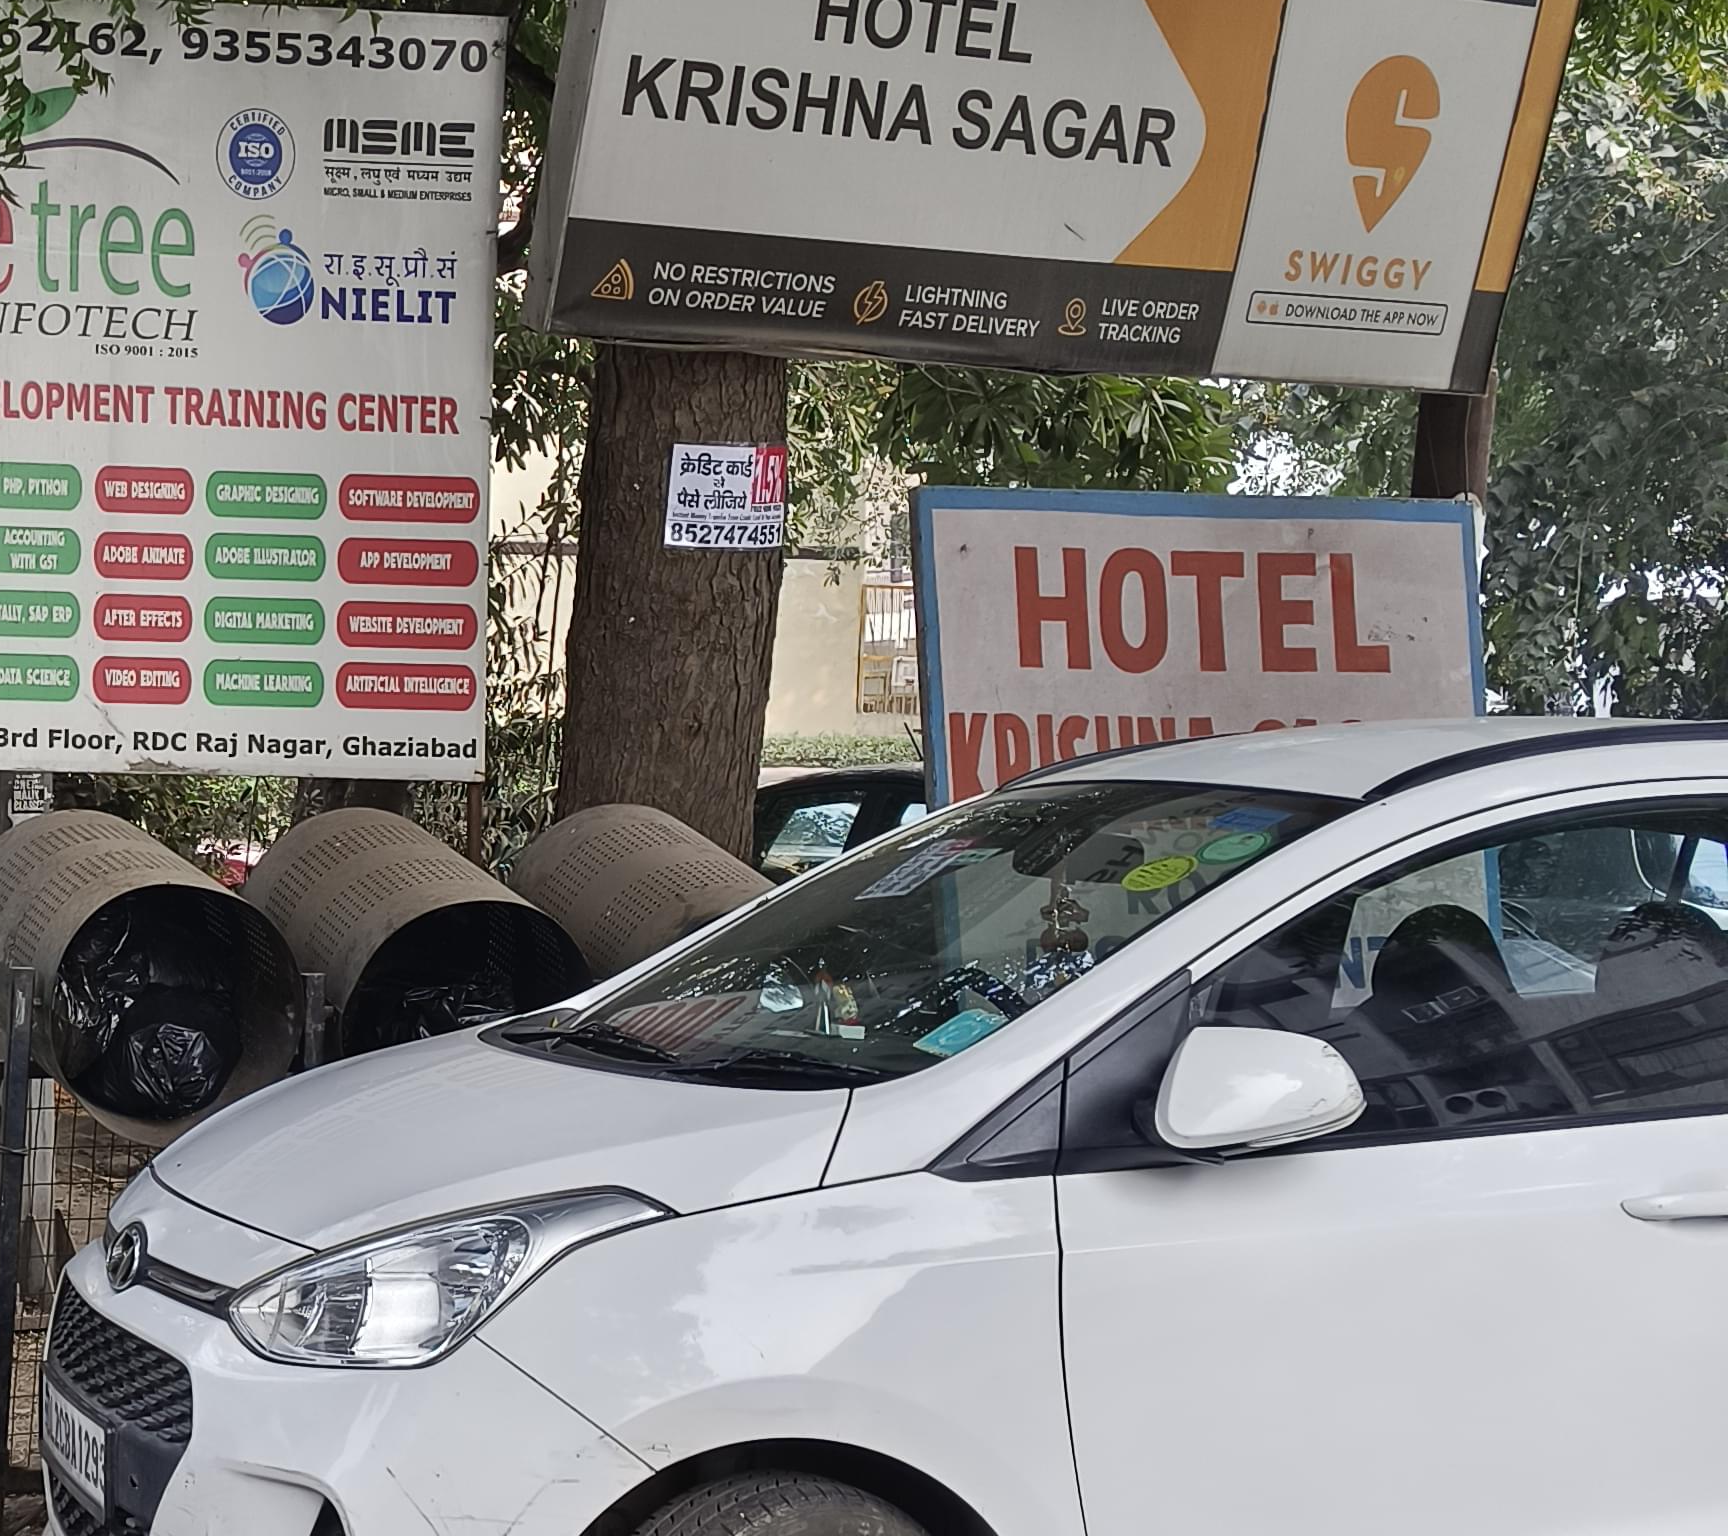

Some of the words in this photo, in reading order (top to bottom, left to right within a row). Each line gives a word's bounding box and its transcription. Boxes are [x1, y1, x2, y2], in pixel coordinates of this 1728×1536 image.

[181, 27, 488, 72] 9355343070
[621, 54, 932, 144] KRISHNA
[952, 89, 1176, 167] SAGAR
[230, 112, 286, 135] CERTIFIED
[324, 118, 475, 158] MSME
[238, 141, 275, 159] ISO
[228, 175, 282, 197] COMPANY
[353, 188, 378, 199] SMALL
[419, 191, 472, 202] ENTERPRISES
[30, 179, 195, 298] tree
[653, 261, 685, 281] NO
[690, 265, 836, 294] RESTRICTIONS
[1284, 249, 1432, 291] SWIGGY
[321, 286, 456, 324] NIELIT
[648, 288, 680, 307] ON
[685, 291, 755, 313] ORDER
[761, 297, 826, 319] VALUE
[905, 284, 1008, 310] LIGHTNING
[1101, 298, 1139, 317] LIVE
[1142, 300, 1200, 321] ORDER
[1285, 304, 1356, 323] DOWNLOAD
[1359, 308, 1381, 324] THE
[1382, 310, 1405, 325] APP
[1407, 312, 1439, 328] NOW
[898, 310, 948, 330] FAST
[952, 313, 1040, 338] DELIVERY
[1098, 324, 1181, 344] TRACKING
[95, 343, 121, 356] ISO
[123, 344, 154, 357] 9001
[167, 345, 198, 359] 2015
[164, 386, 327, 431] TRAINING
[337, 392, 459, 435] CENTER
[28, 478, 69, 497] PYTHON
[104, 480, 128, 497] WEB
[131, 481, 186, 500] DESIGNING
[216, 484, 261, 502] GRAPHIC
[265, 485, 319, 505] DESIGNING
[349, 489, 403, 507] SOFTWARE
[407, 491, 474, 509] DEVELOPMENT
[3, 529, 65, 547] ACCOUNTING
[671, 523, 782, 545] 8527474551
[10, 552, 36, 570] WITH
[40, 553, 58, 570] GST
[103, 545, 138, 563] ADOBE
[142, 546, 185, 565] ANIMATE
[215, 546, 250, 564] ADOBE
[254, 547, 317, 567] ILLUSTRATOR
[360, 552, 379, 569] APP
[384, 553, 452, 571] DEVELOPMENT
[29, 605, 49, 623] SAP
[52, 605, 72, 624] ERP
[103, 609, 136, 627] AFTER
[140, 610, 183, 628] EFFECTS
[1013, 546, 1391, 674] HOTEL
[214, 611, 252, 629] DIGITAL
[255, 612, 314, 632] MARKETING
[349, 616, 393, 634] WEBSITE
[396, 617, 464, 636] DEVELOPMENT
[27, 669, 70, 687] SCIENCE
[105, 669, 136, 688] VIDEO
[140, 670, 180, 689] EDITING
[216, 673, 260, 691] MACHINE
[263, 674, 313, 693] LEARNING
[346, 675, 400, 693] ARTIFICIAL
[404, 676, 470, 695] INTELLIGENCE
[48, 729, 123, 754] Floor,
[133, 731, 187, 753] RDC
[196, 732, 238, 757] Raj
[248, 734, 333, 759] Nagar,
[342, 735, 477, 760] Ghaziabad
